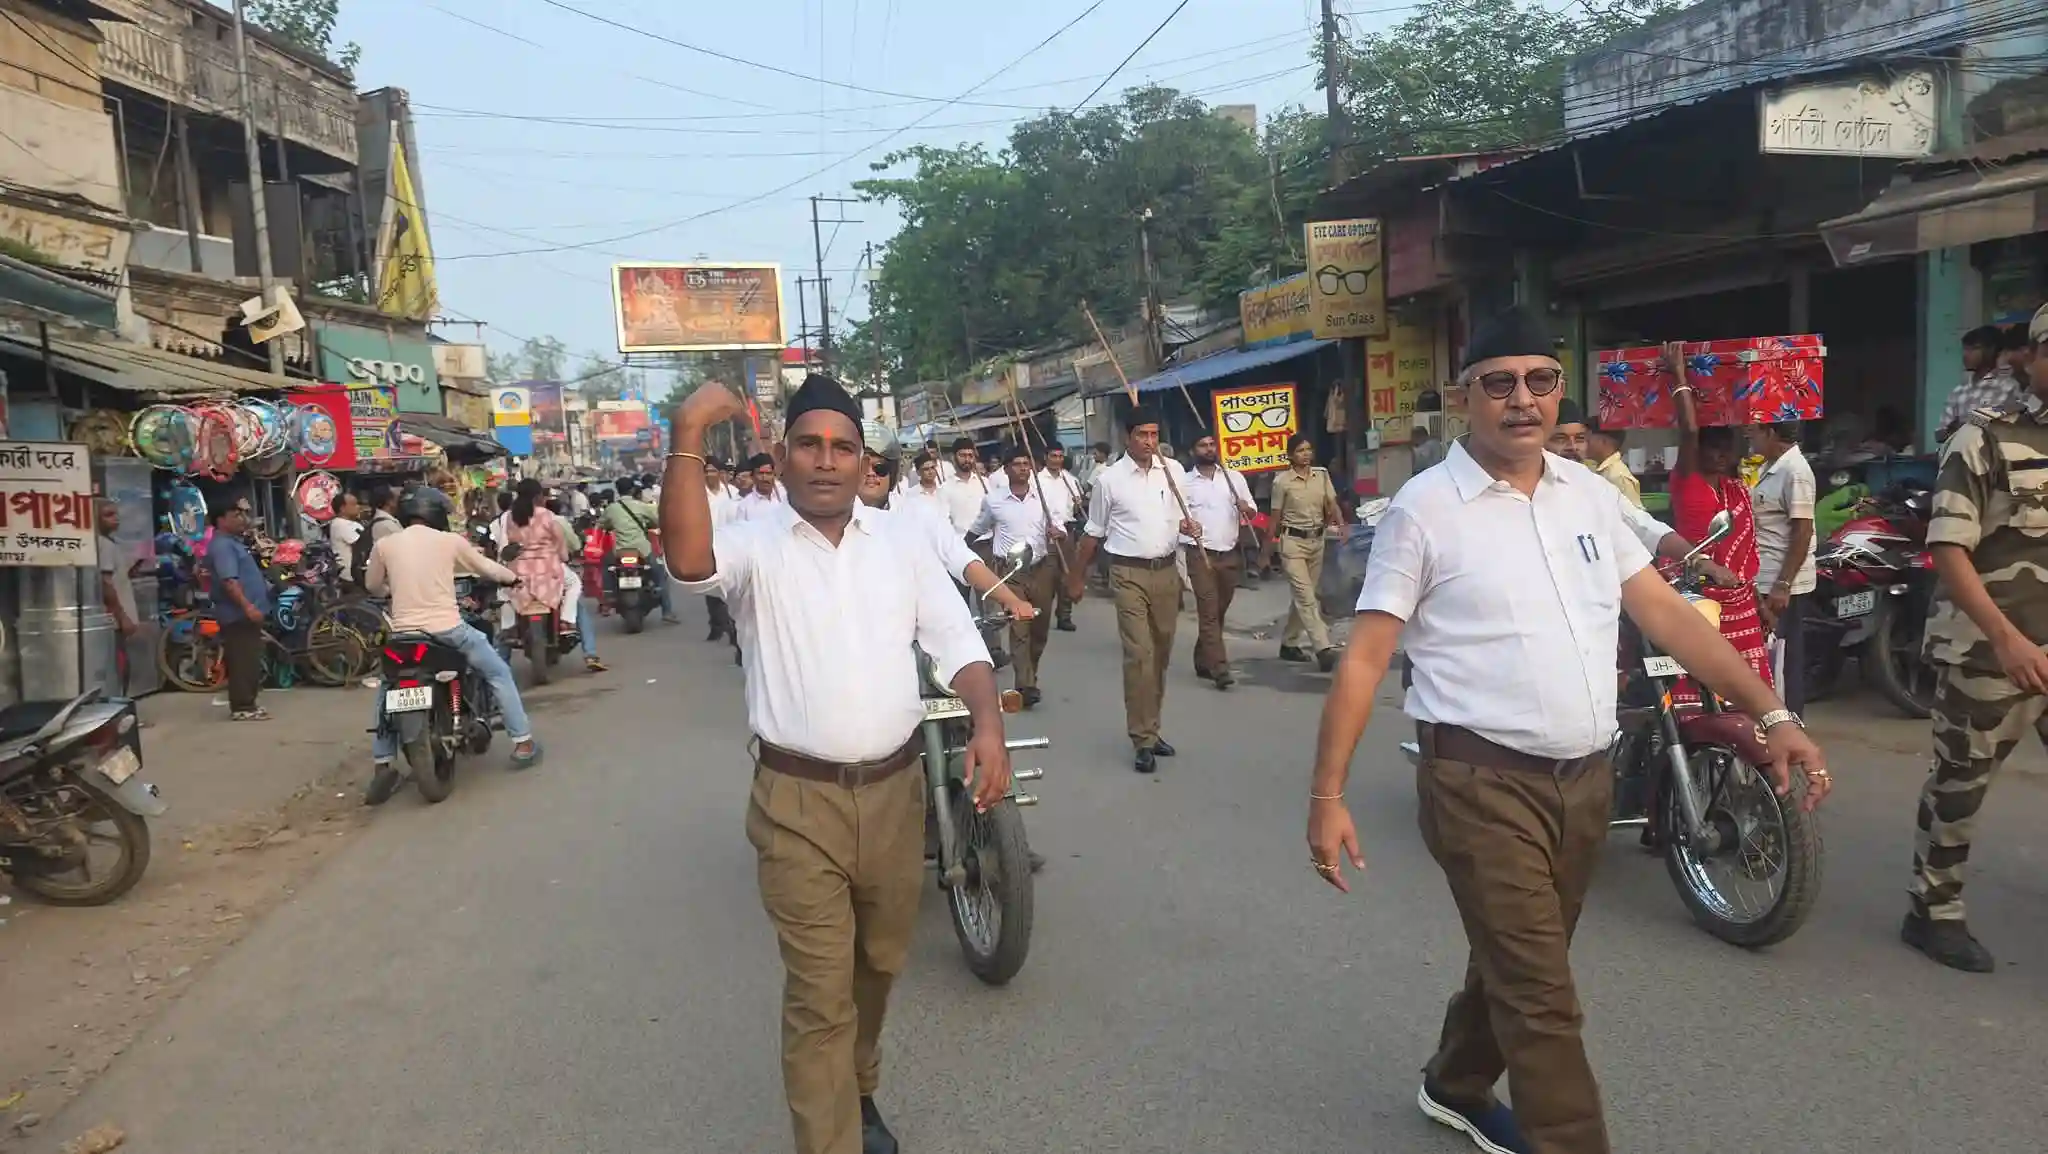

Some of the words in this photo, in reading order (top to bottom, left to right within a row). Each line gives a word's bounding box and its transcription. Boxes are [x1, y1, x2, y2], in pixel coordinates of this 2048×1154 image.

[1313, 225, 1328, 239] EYE
[1328, 224, 1347, 238] CARE
[1326, 312, 1346, 328] Sun
[1347, 311, 1376, 326] Glass
[1398, 359, 1431, 370] POWER
[1220, 391, 1290, 409] পাওয়ার
[1400, 402, 1415, 416] FRA
[1254, 455, 1274, 466] করা
